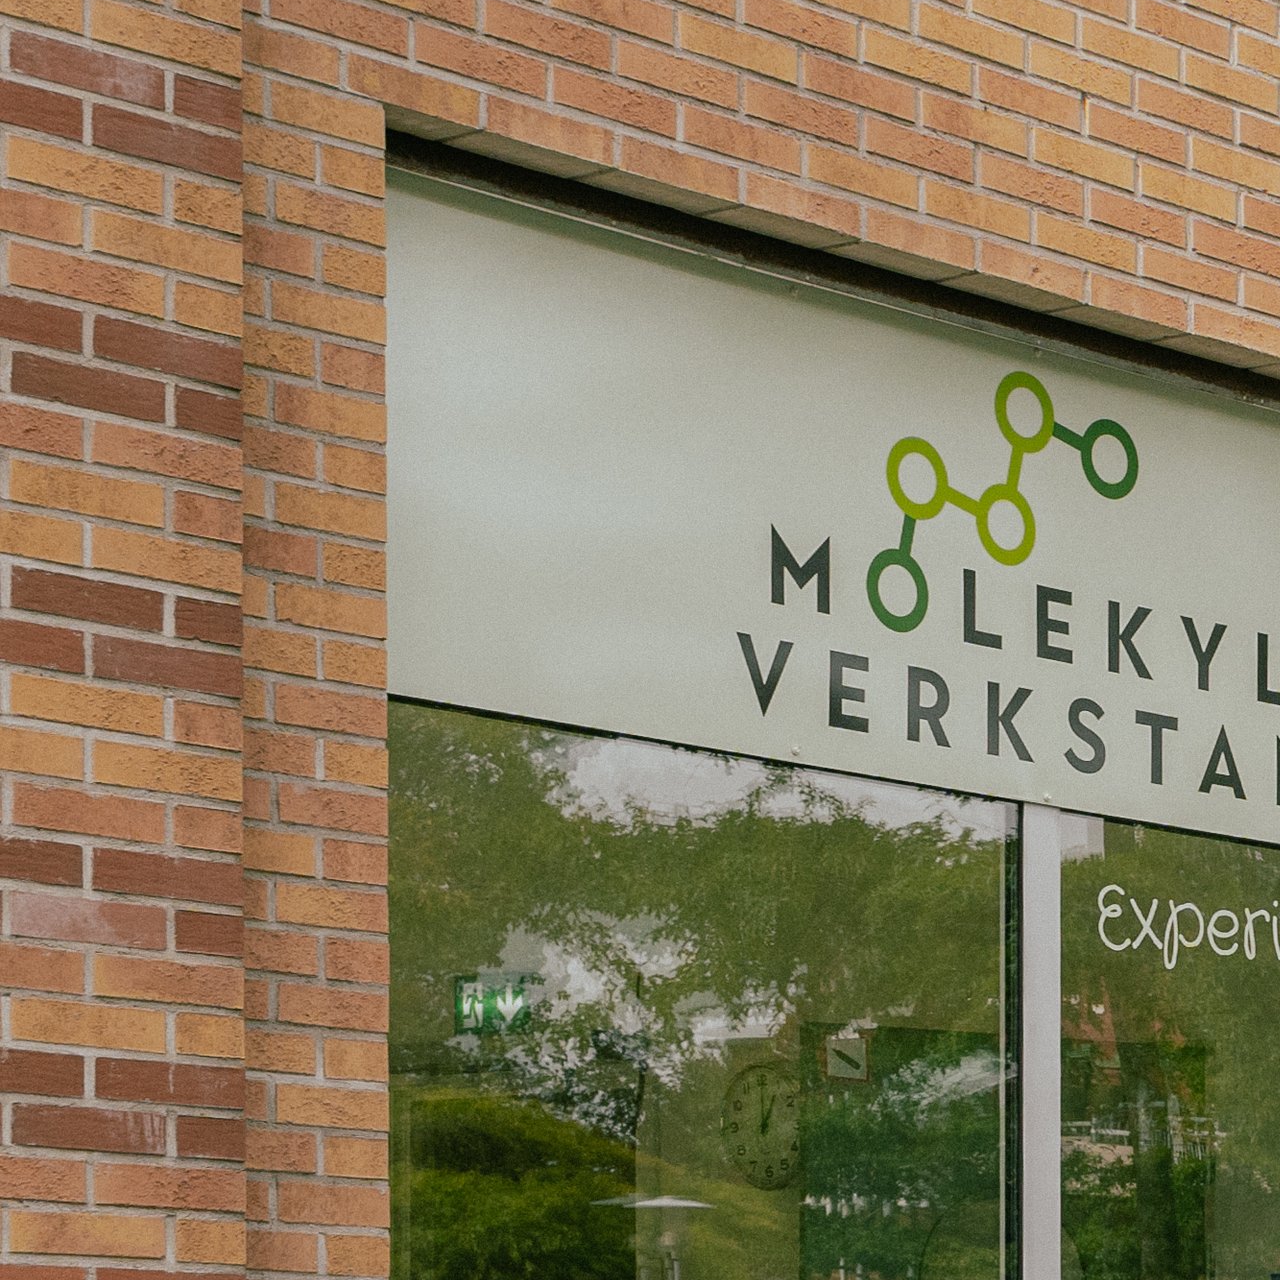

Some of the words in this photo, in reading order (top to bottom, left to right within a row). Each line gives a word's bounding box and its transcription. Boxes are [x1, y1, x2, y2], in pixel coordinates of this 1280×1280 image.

[730, 1122, 739, 1133] 9
[780, 1159, 790, 1170] 5
[765, 1165, 774, 1177] 6
